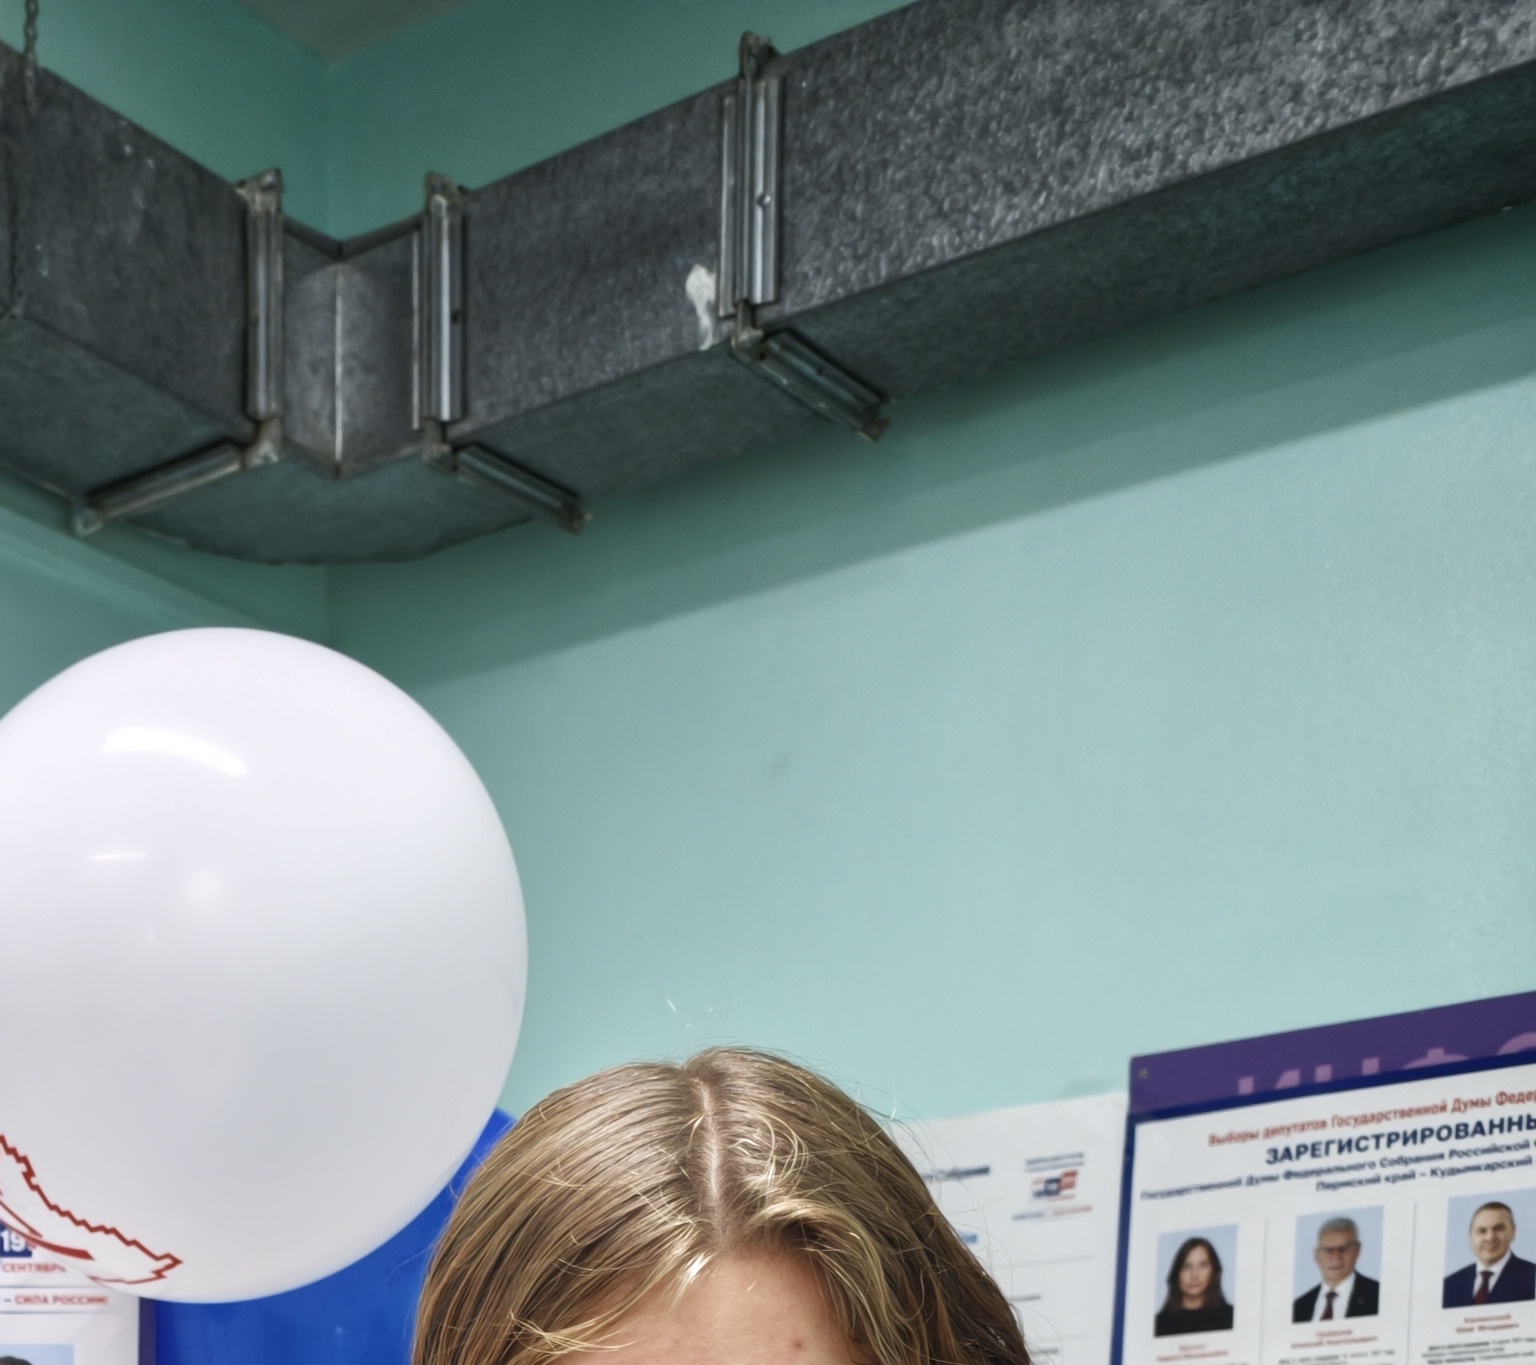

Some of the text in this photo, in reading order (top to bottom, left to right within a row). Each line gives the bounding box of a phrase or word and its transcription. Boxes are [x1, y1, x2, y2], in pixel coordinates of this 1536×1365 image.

[1262, 1117, 1327, 1139] депутатов
[1331, 1101, 1448, 1127] Государственной
[1451, 1097, 1492, 1114] Думы
[1495, 1088, 1536, 1107] Феде
[1448, 1139, 1530, 1160] Российской
